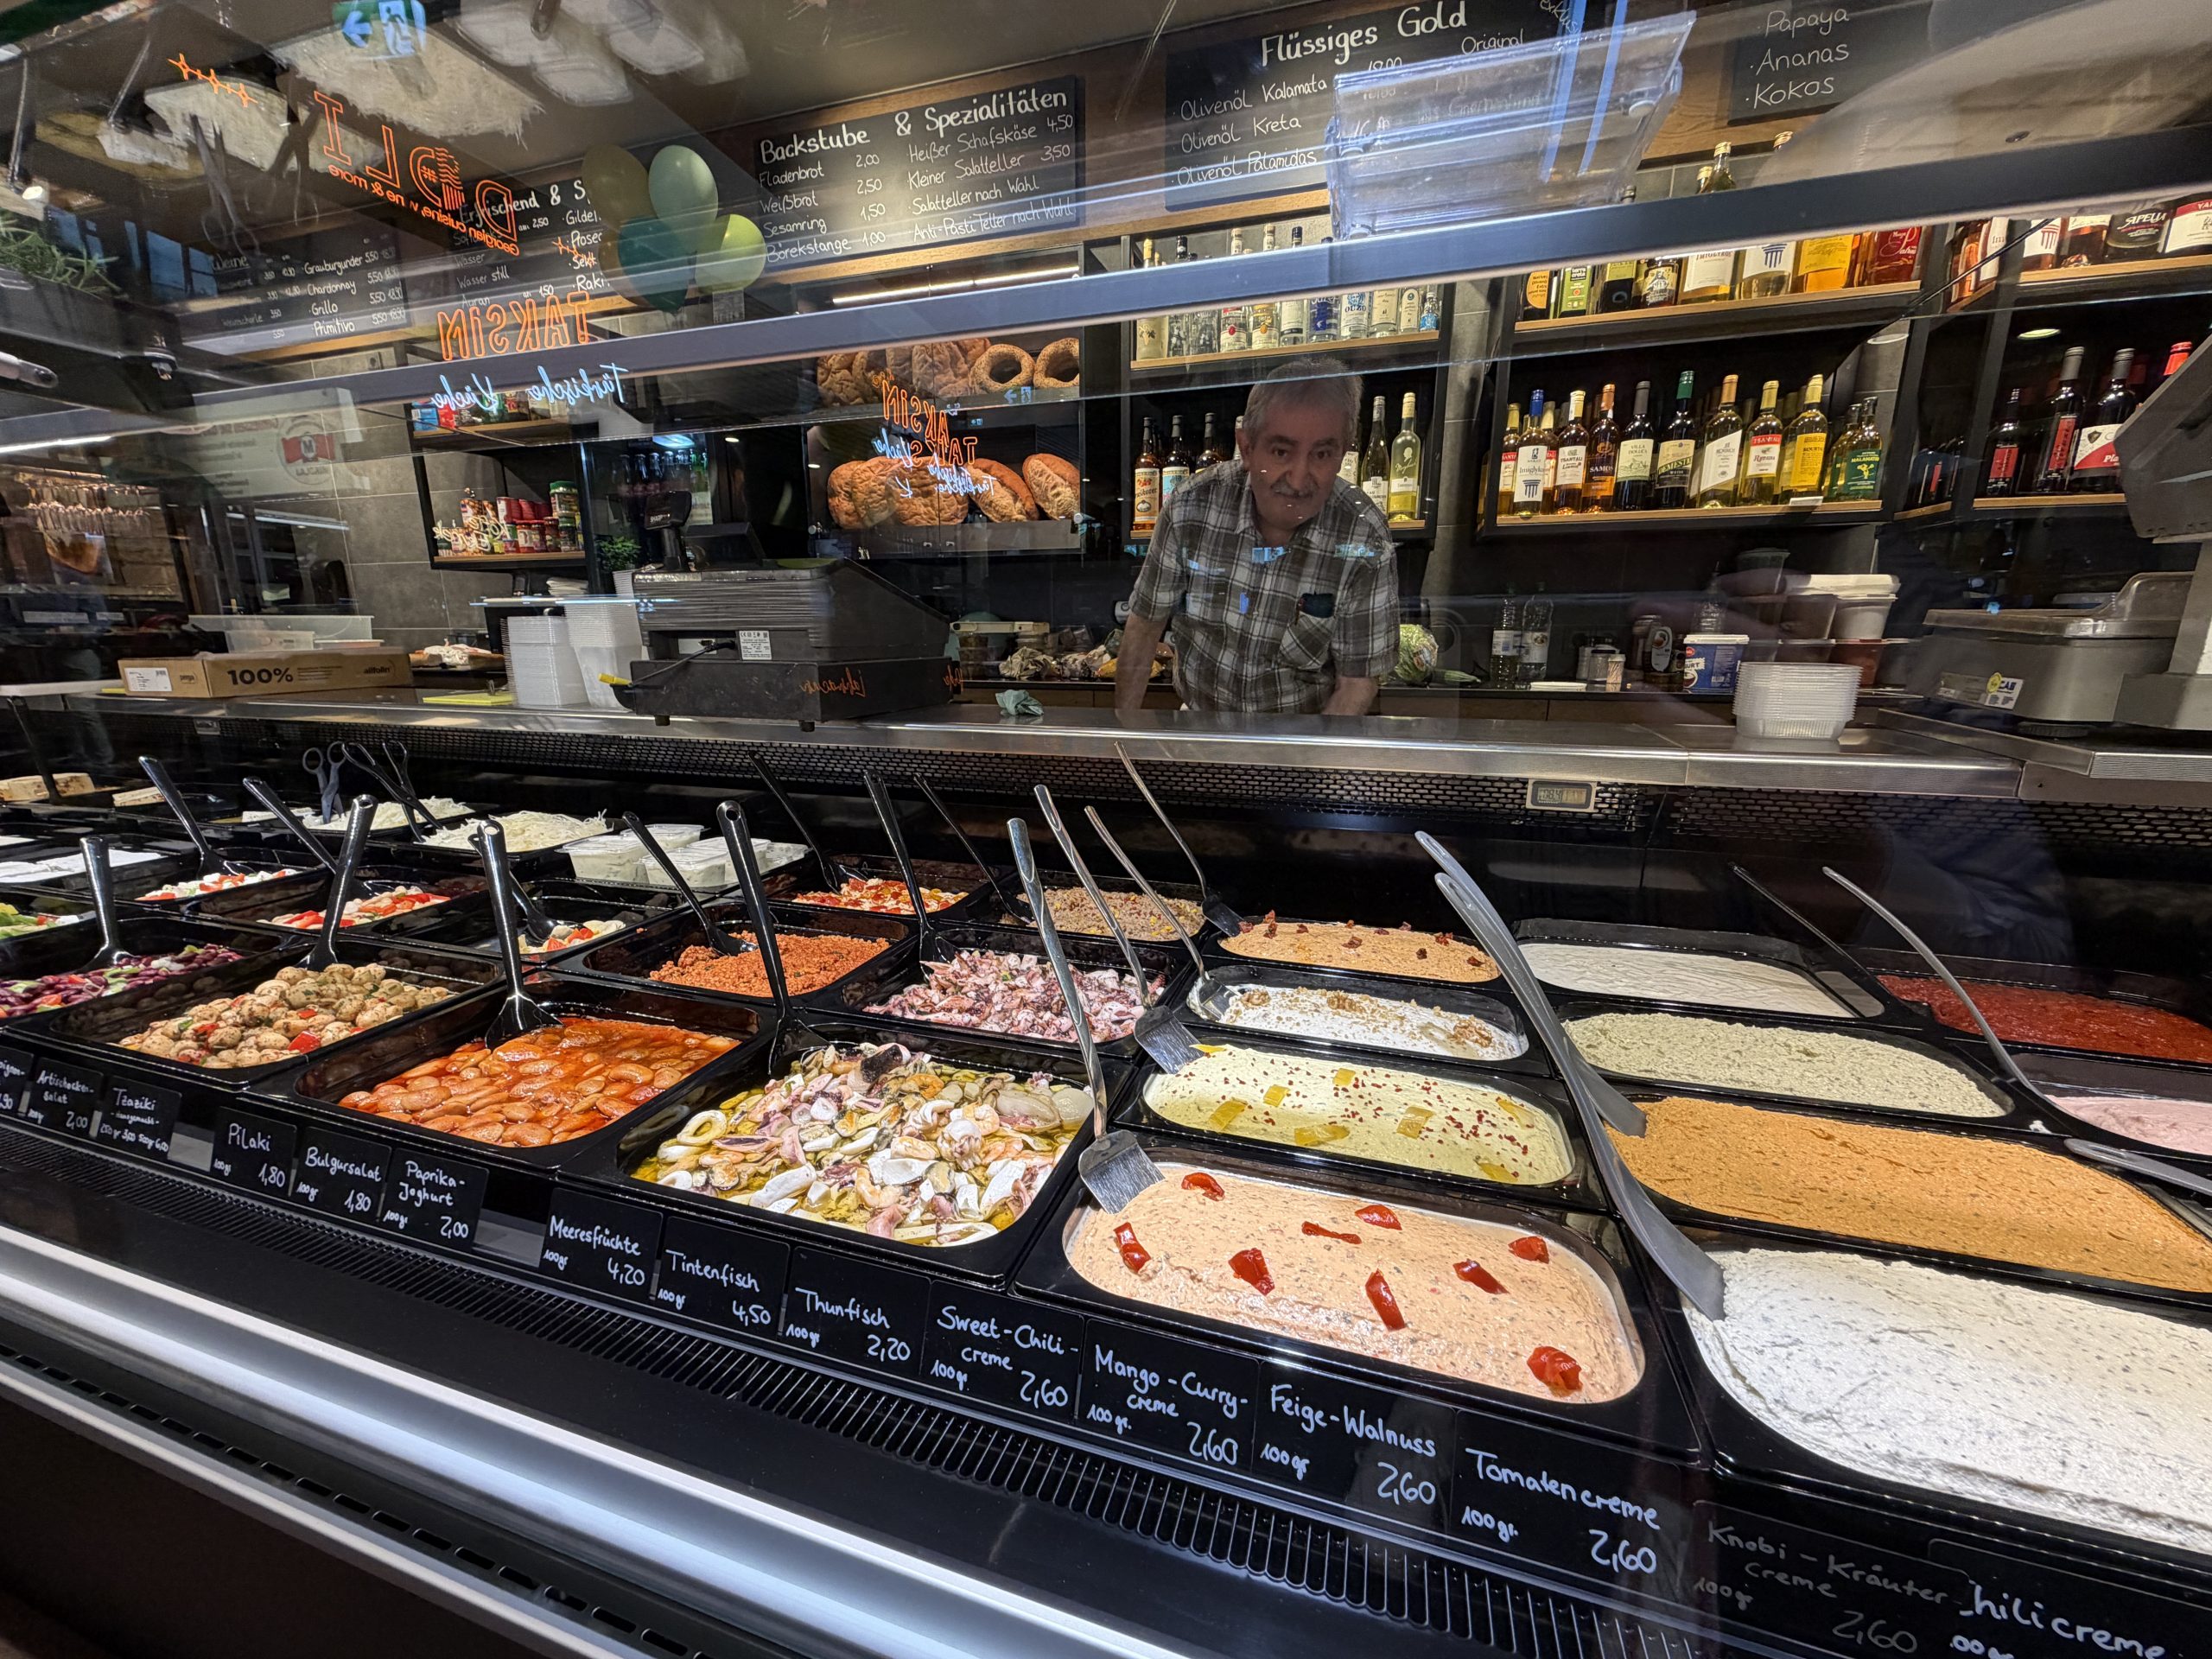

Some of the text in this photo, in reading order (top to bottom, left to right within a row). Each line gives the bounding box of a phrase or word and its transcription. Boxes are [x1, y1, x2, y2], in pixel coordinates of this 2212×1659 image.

[1262, 0, 1467, 67] Flüssiges Gold
[1461, 28, 1524, 54] Original
[1765, 9, 1849, 38] Papaya
[1756, 44, 1849, 76] Ananas
[1180, 92, 1253, 121] Olivenöl
[1262, 77, 1327, 104] Kalamata
[760, 88, 1068, 165] Backstube & Spezialitäten
[908, 113, 1074, 163] Heißer Schafskäse 4,50
[1181, 115, 1302, 153] Olivenöl Kreta
[759, 154, 880, 188] Fladenbrot 2,00
[908, 144, 1071, 191] Kleiner Salatteller 3,50
[1177, 149, 1318, 187] Olivenöl Palamidas
[550, 184, 561, 207] &
[760, 178, 883, 215] Weißbrot 2,50
[912, 174, 1039, 216] Salatteller nach Wahl
[763, 202, 887, 239] Sesamring 1,50
[973, 212, 1006, 234] Teller
[1012, 207, 1040, 225] nach
[1041, 197, 1074, 219] Wahl
[766, 230, 887, 263] Börekstange 1,00
[304, 255, 363, 276] Grauburgunder
[457, 264, 510, 289] Wasser still
[307, 278, 357, 296] Chardonnay
[311, 301, 339, 316] Grillo
[1344, 304, 1366, 313] OUZO
[313, 318, 355, 337] Primitivo
[226, 667, 294, 685] 100%
[113, 1087, 156, 1111] Tzaziki
[66, 1110, 88, 1130] 2,00
[227, 1123, 271, 1152] Pilaki
[258, 1163, 286, 1188] 1,80
[304, 1147, 383, 1182] Bulgursalat
[405, 1160, 467, 1188] Paprika-
[344, 1189, 372, 1213] 1,80
[398, 1181, 454, 1208] Joghurt
[440, 1216, 469, 1239] 2,00
[549, 1214, 641, 1256] Meeresfrüchte
[543, 1249, 645, 1287] 100gr 4,20
[665, 1249, 761, 1293] Tintenfisch
[658, 1288, 772, 1326] 100gr 4,50
[795, 1287, 891, 1329] Thunfisch
[785, 1323, 911, 1362] 100gr 2,20
[961, 1345, 1014, 1371] creme
[1020, 1370, 1069, 1409] 2,60
[1127, 1393, 1179, 1418] creme
[1270, 1383, 1437, 1459] Feige-Walnuss
[1186, 1421, 1238, 1467] 2,60
[1376, 1461, 1436, 1506] 2,60
[1465, 1446, 1661, 1531] Tomatencreme
[1588, 1529, 1658, 1574] 2,60
[1831, 1609, 1917, 1654] 2,60
[1959, 1584, 2165, 1659] hilicreme
